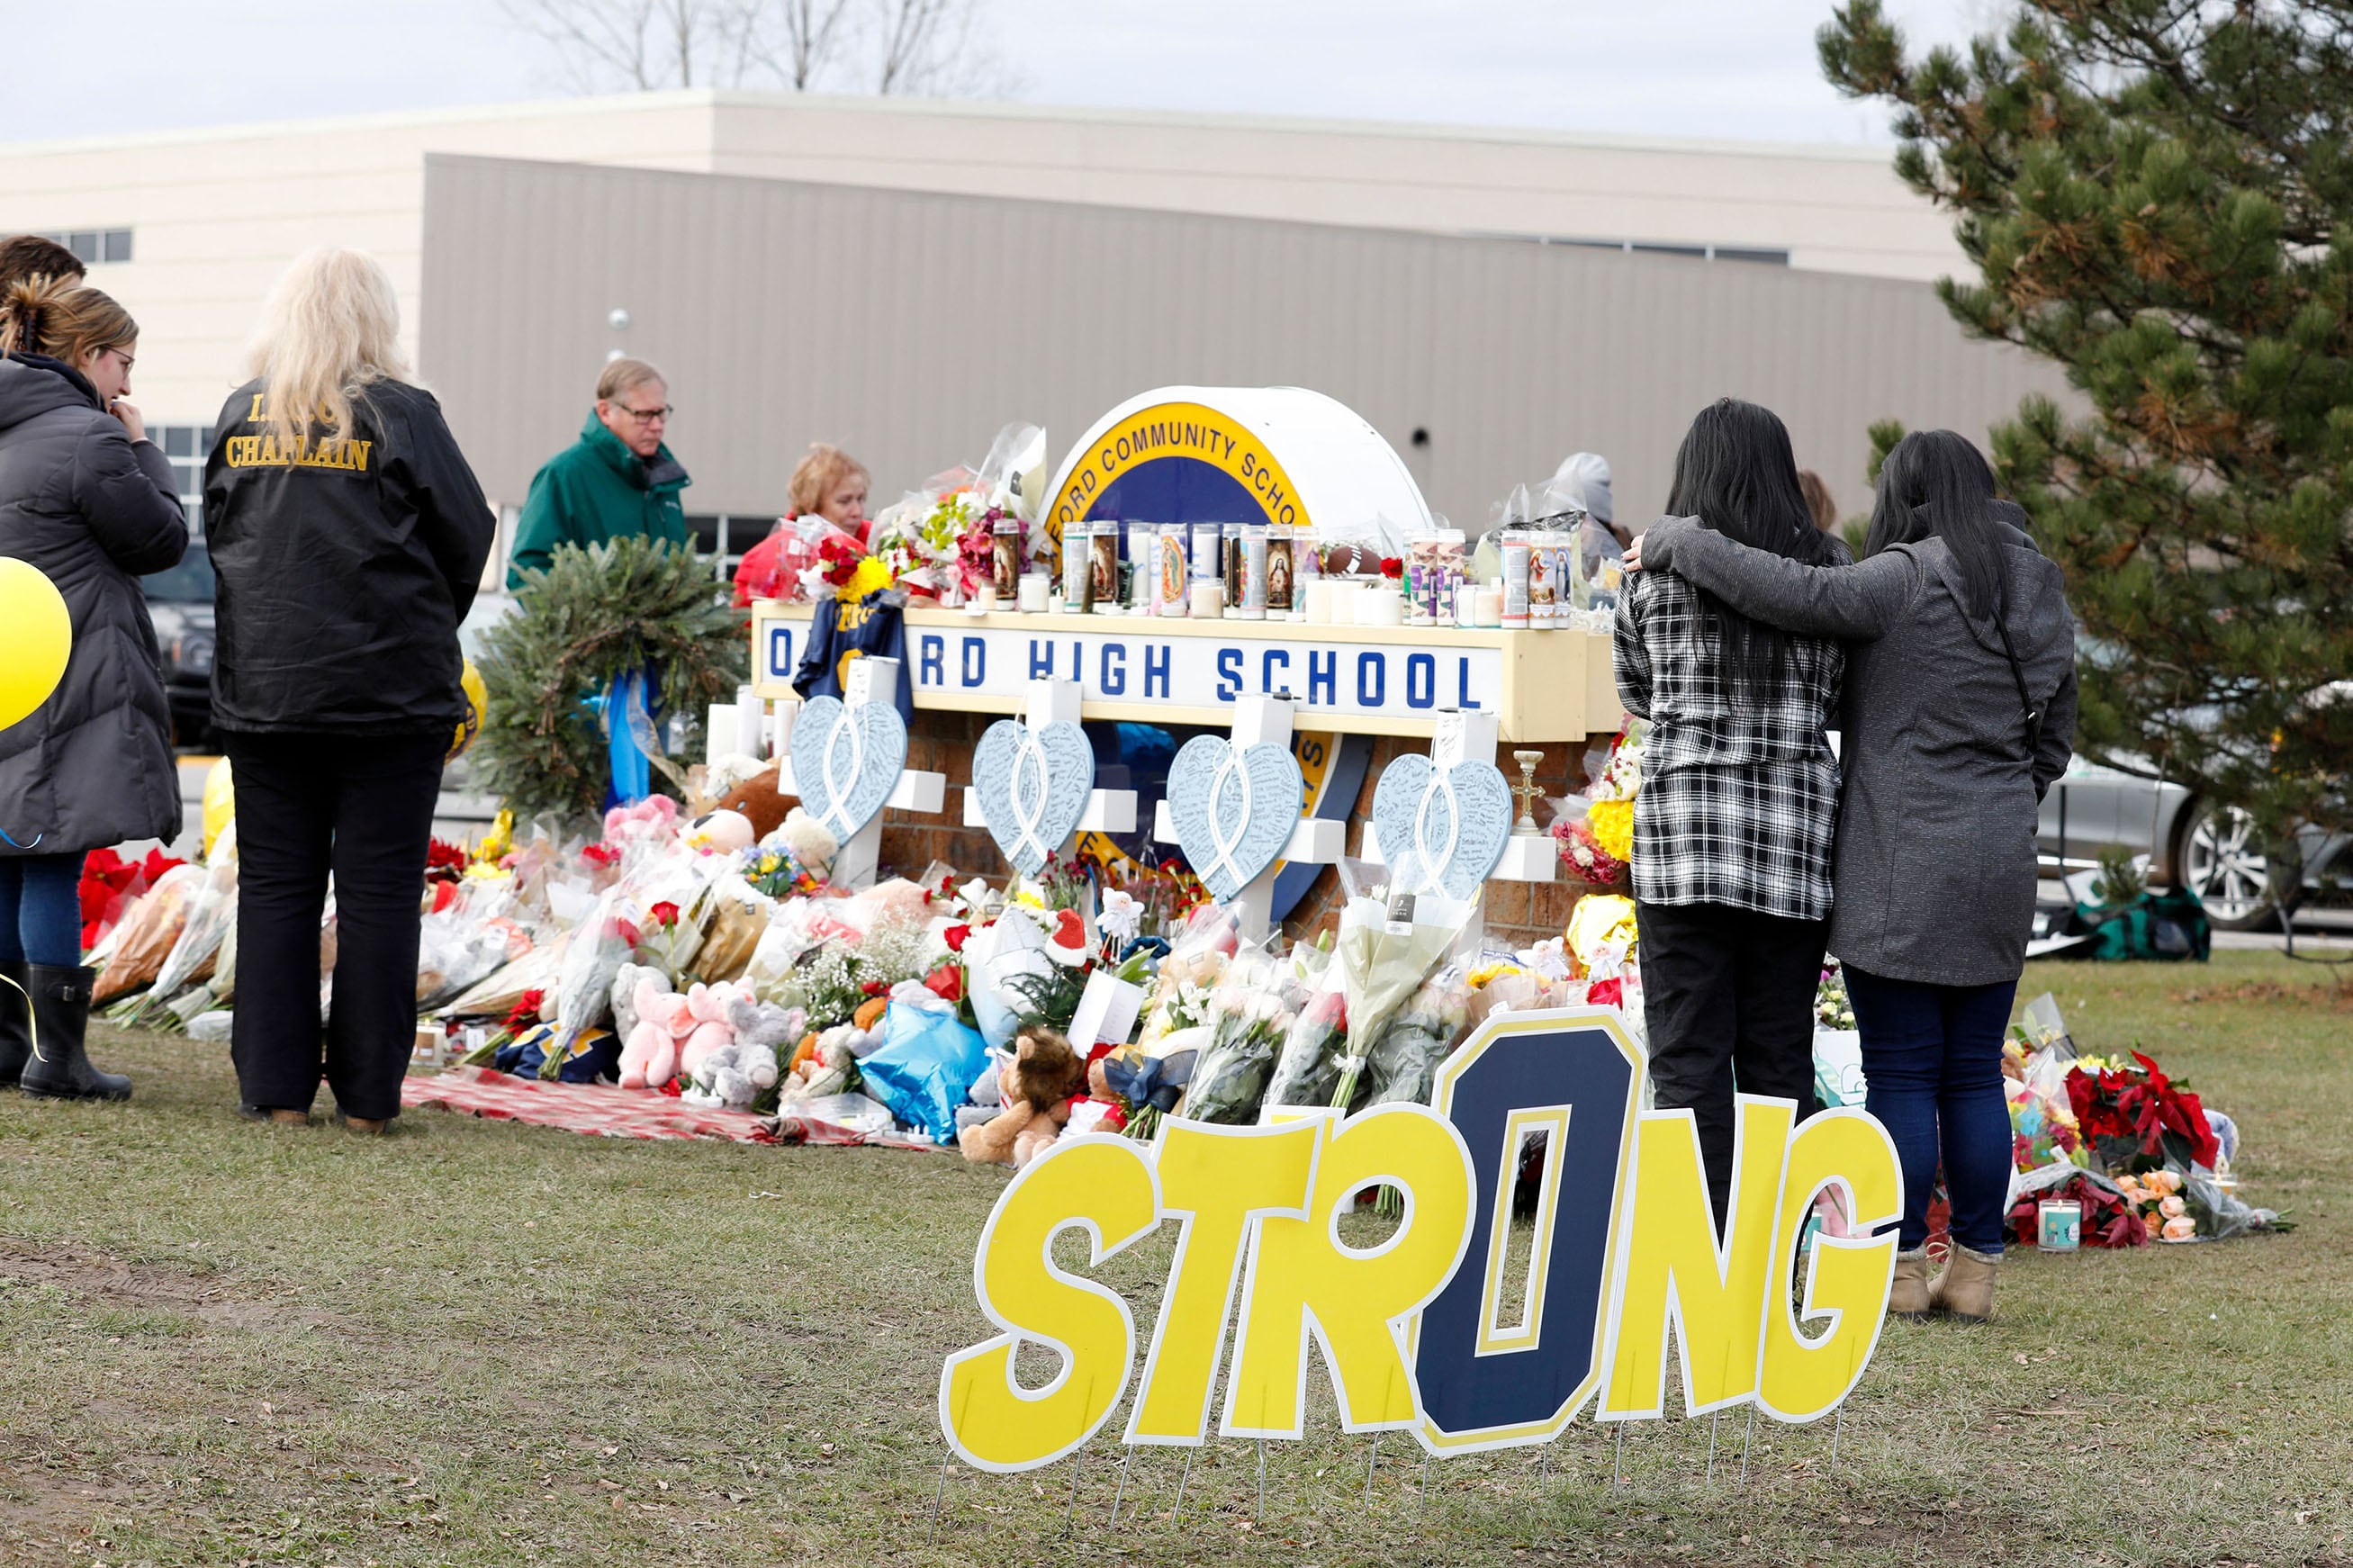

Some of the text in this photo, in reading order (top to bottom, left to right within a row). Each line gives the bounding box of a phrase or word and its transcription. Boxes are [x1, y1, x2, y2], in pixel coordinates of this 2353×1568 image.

[1101, 421, 1236, 472] COMMUNITY
[1240, 452, 1295, 525] SCHO
[771, 628, 986, 687] ORD
[1029, 640, 1170, 698] HIGH
[1217, 648, 1481, 709] SCHOOL
[938, 1005, 1905, 1474] STRONG
